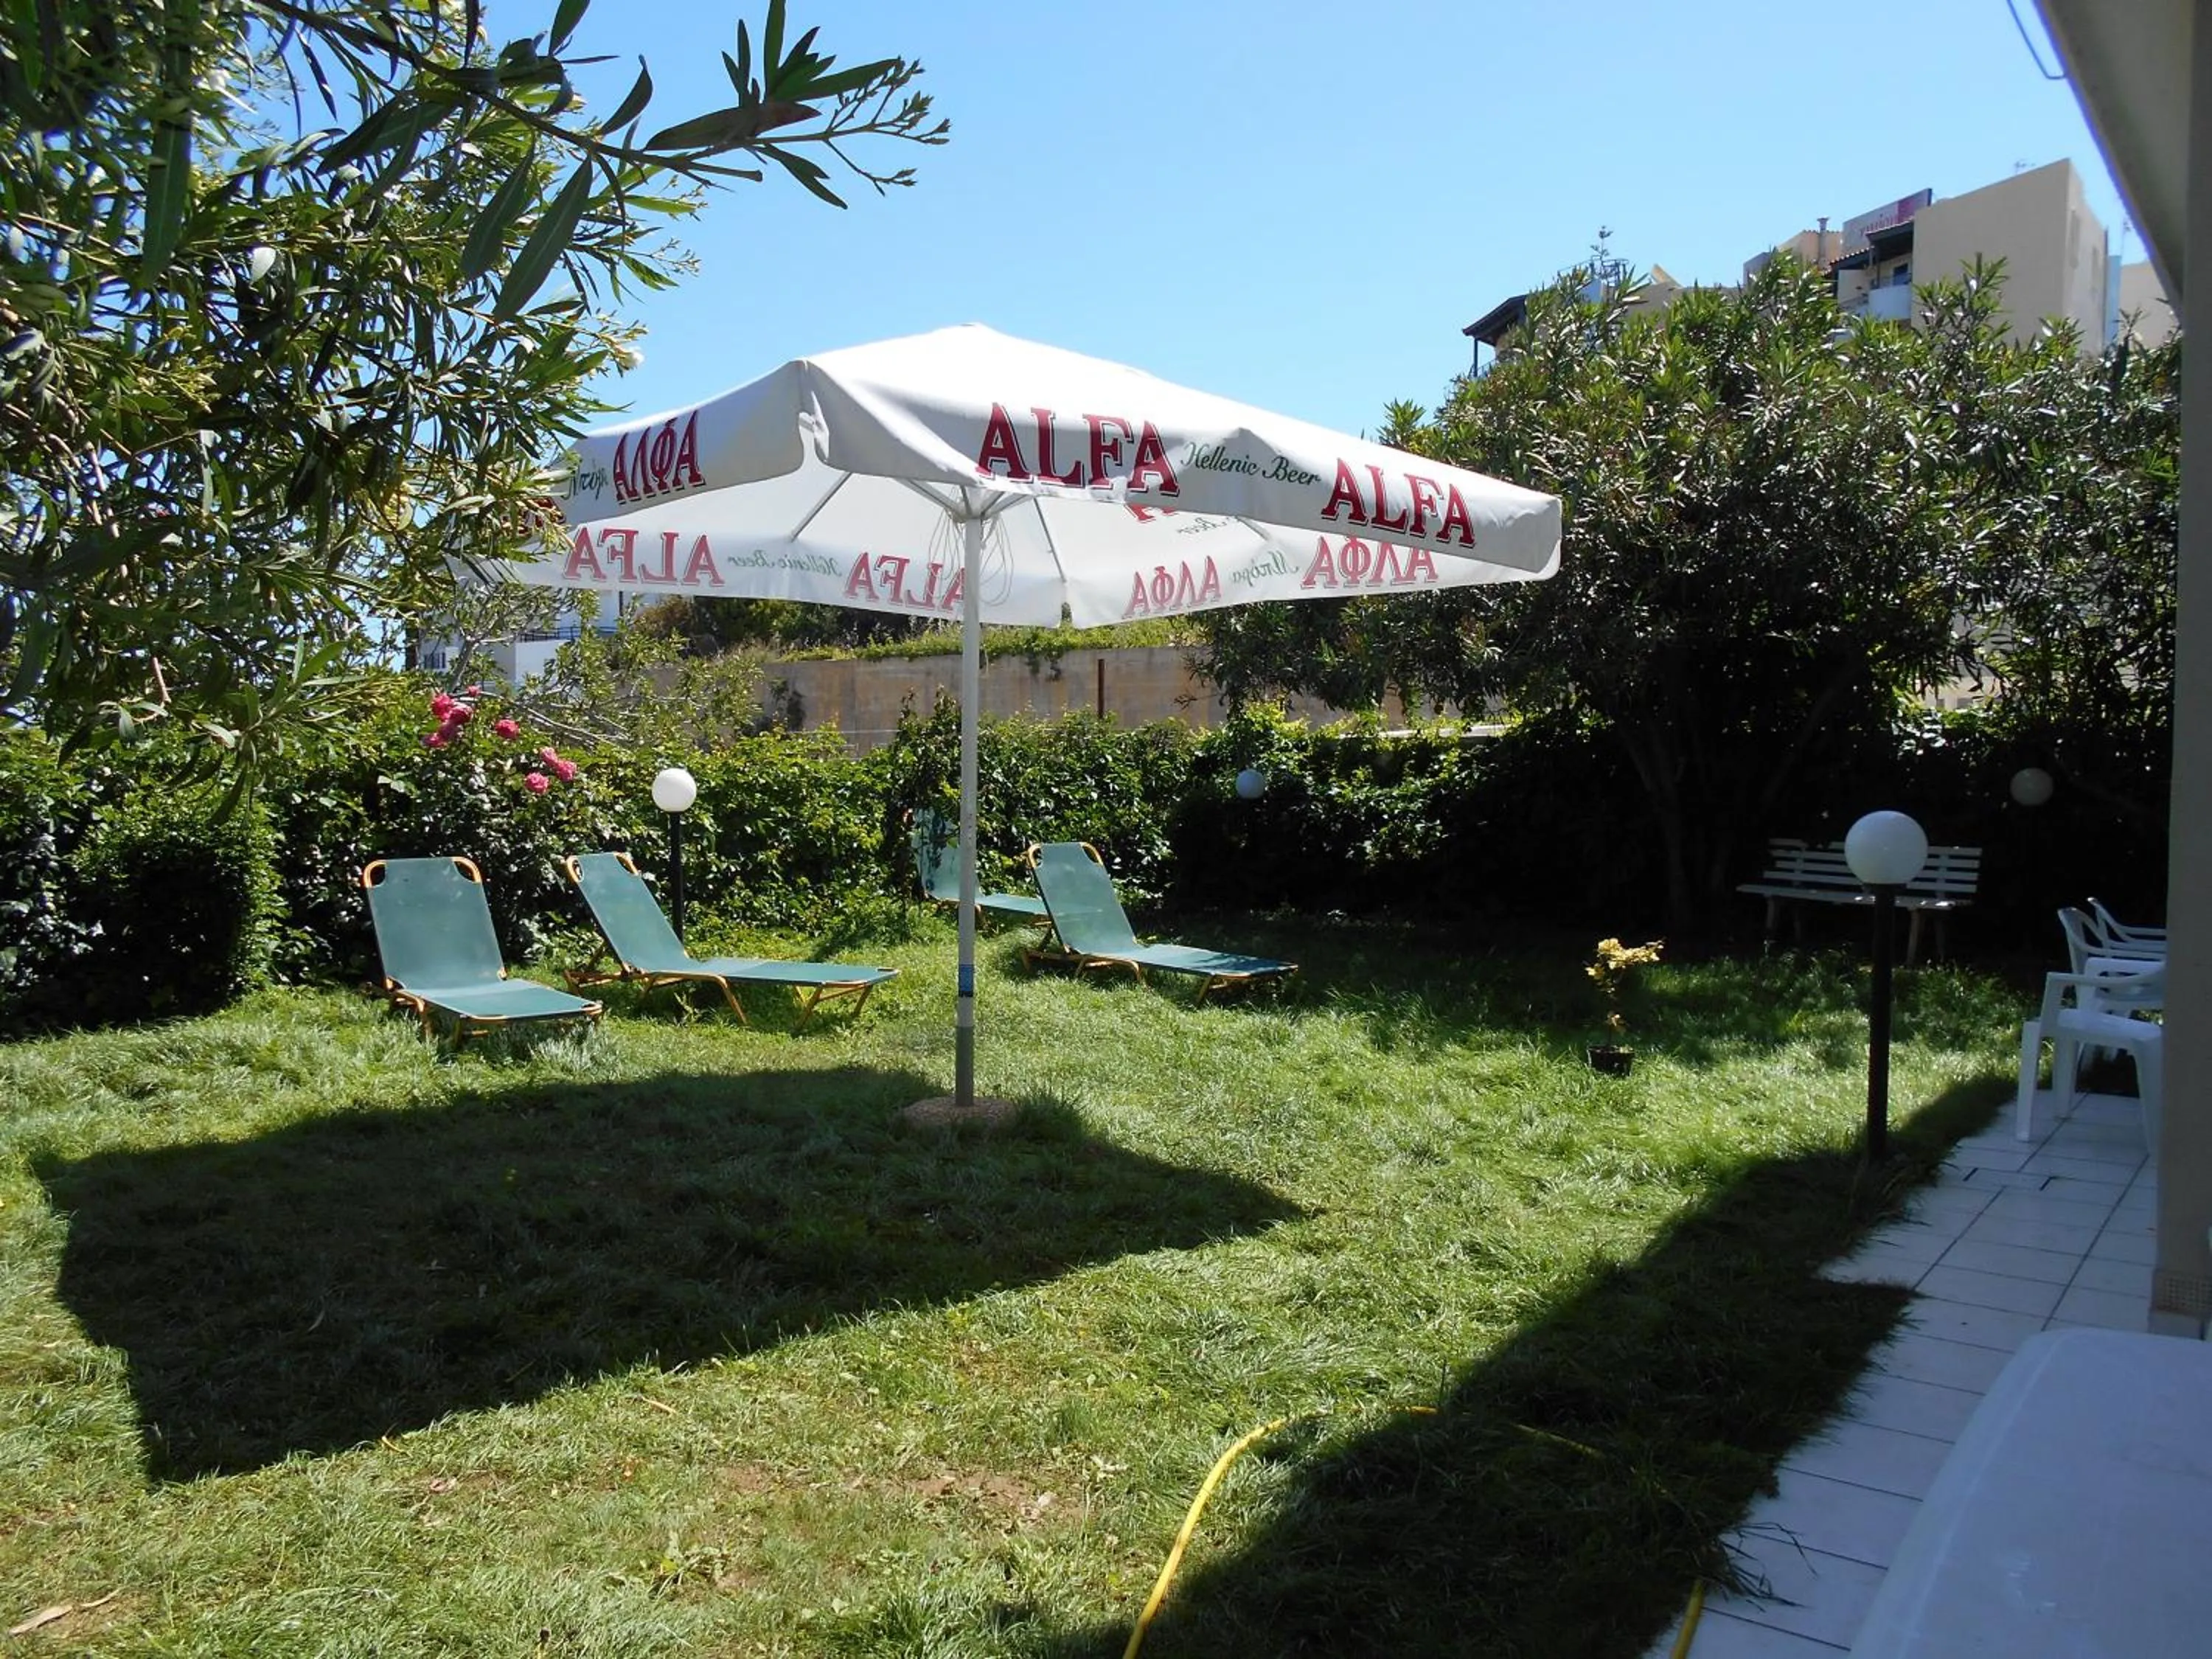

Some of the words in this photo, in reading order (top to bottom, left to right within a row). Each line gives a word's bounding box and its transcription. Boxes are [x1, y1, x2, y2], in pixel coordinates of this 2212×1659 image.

[974, 402, 1180, 497] ALFA
[1180, 442, 1259, 476] Hellenic
[1262, 455, 1321, 487] Beer
[1320, 458, 1475, 548] ALFA
